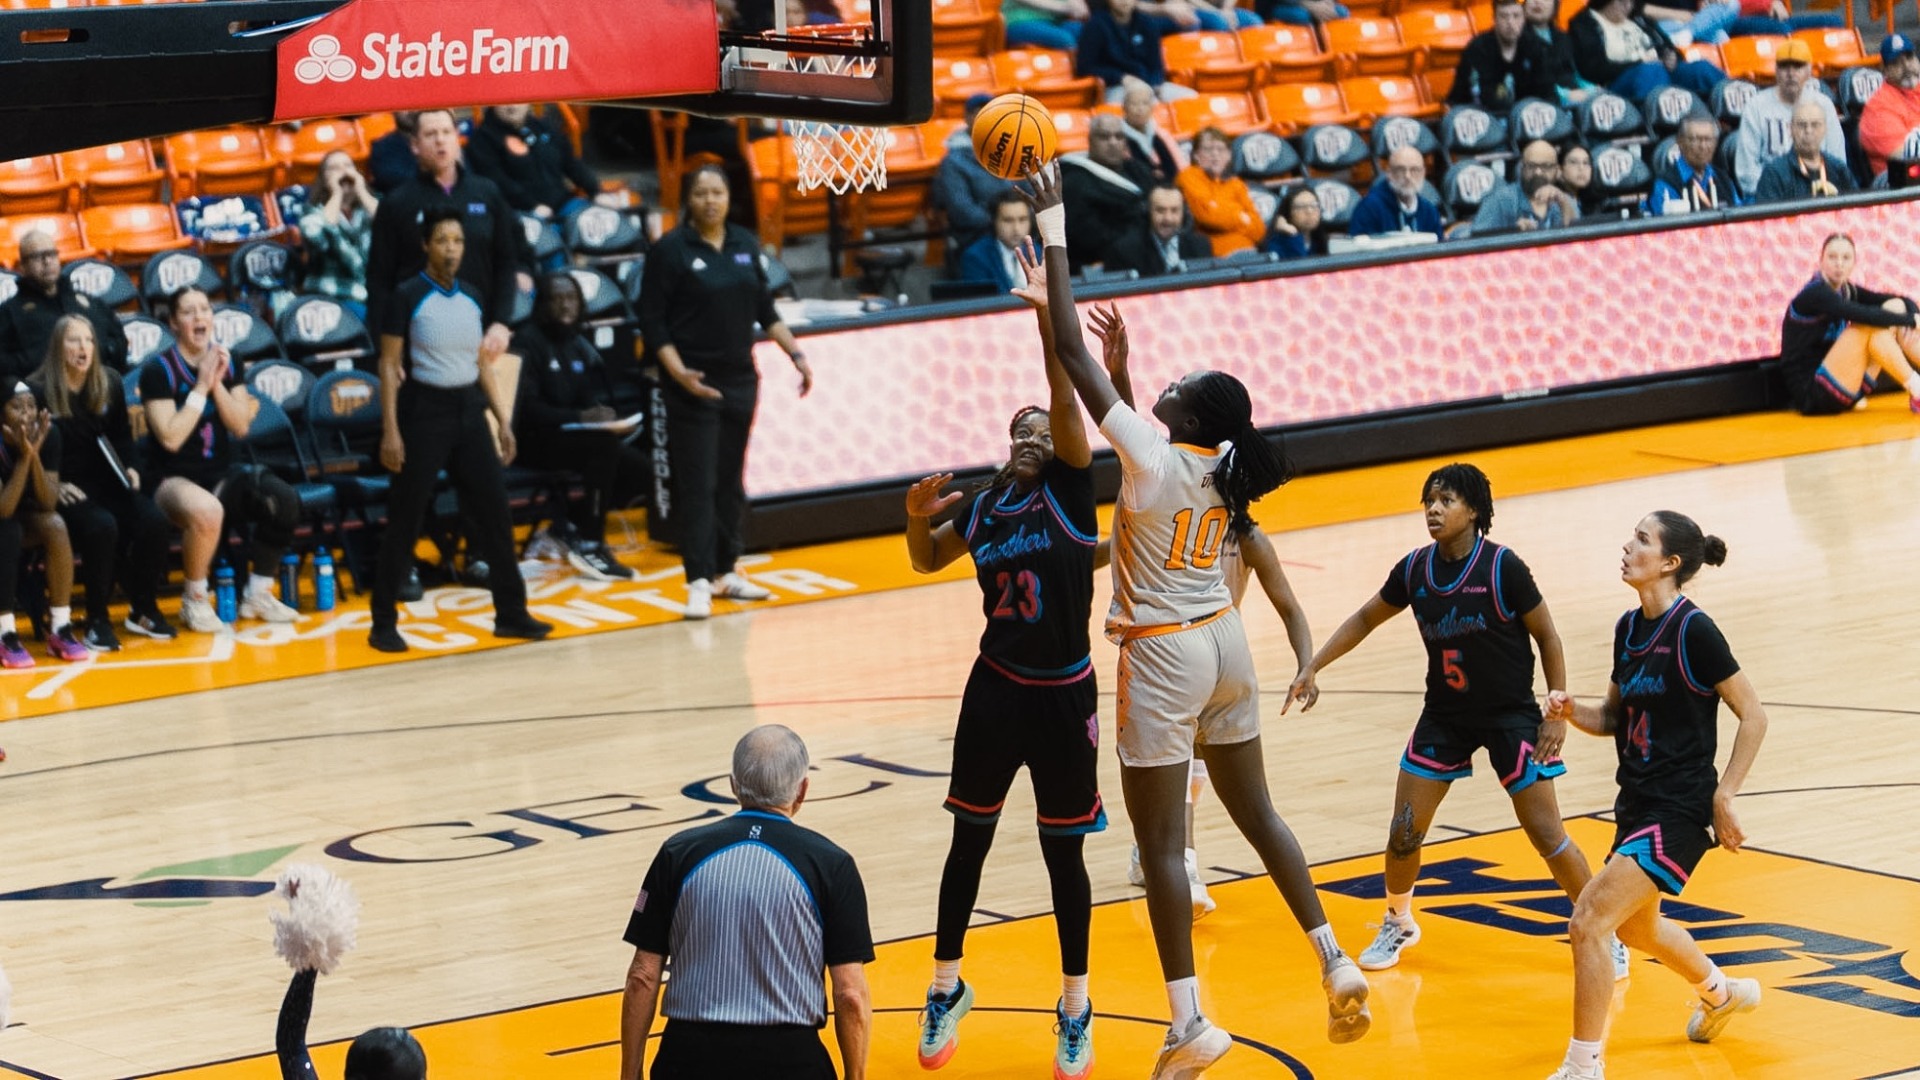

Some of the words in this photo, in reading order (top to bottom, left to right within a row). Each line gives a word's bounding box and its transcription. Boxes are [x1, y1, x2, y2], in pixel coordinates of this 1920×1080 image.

[987, 131, 1013, 176] Wilson
[650, 387, 671, 518] CHEVROLET
[1164, 506, 1229, 570] 10
[398, 567, 858, 651] CNTR
[992, 569, 1043, 622] 23
[1442, 649, 1469, 692] 5
